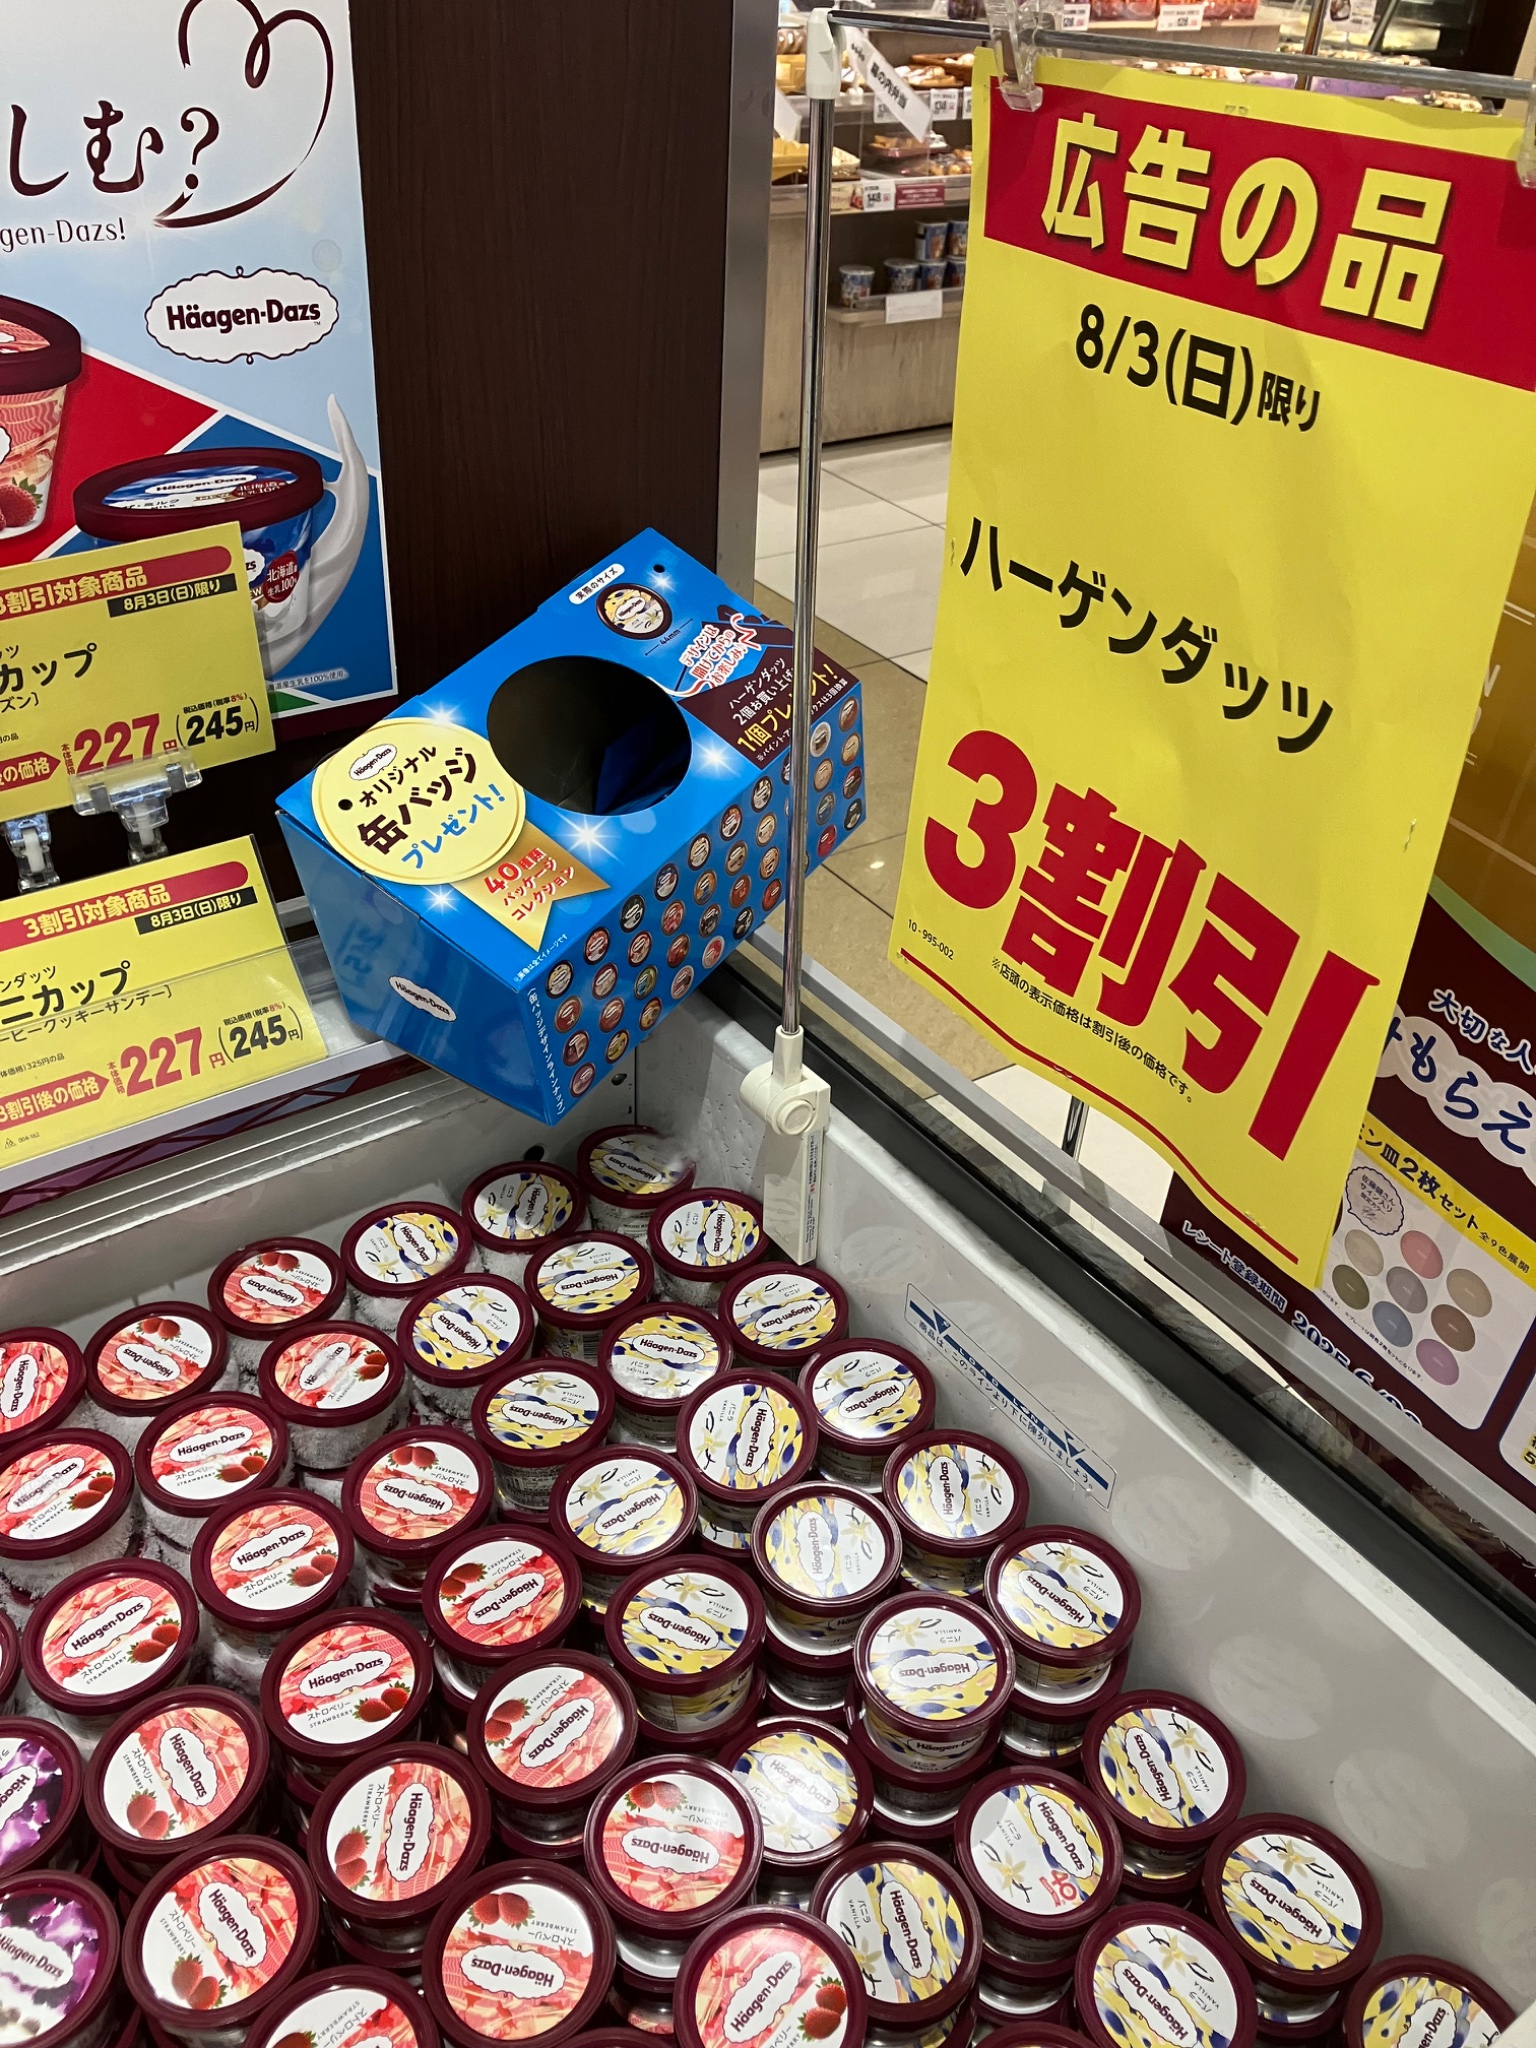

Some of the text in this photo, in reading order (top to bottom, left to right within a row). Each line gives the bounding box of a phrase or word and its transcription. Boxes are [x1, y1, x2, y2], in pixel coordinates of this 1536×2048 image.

[10, 100, 220, 196] しむ?
[1041, 112, 1452, 331] 広告の品
[166, 299, 320, 334] Häagen-Dazs
[1075, 304, 1320, 432] 8/3(日)限り
[157, 476, 247, 492] Häagen-Dazs
[123, 579, 221, 611] 8月3日(日)限り
[575, 567, 618, 600] 実際のサイズ
[660, 629, 681, 645] 44mm
[681, 626, 719, 666] デザインは
[958, 514, 1334, 754] ハーゲンダッツ
[728, 657, 787, 709] ハーゲンダッツ
[0, 761, 51, 785] の価格
[353, 748, 393, 778] Häagen-Dazs
[358, 746, 437, 809] オリジナル
[357, 747, 477, 856] 缶バッジ
[401, 783, 506, 870] プレゼント!
[484, 847, 547, 896] 40種類
[503, 856, 558, 907] パッケージ
[511, 866, 575, 922] コレクション
[23, 883, 171, 939] 3割引対象商品
[150, 893, 242, 928] 8月3日(日)限り
[512, 933, 569, 983] ※画像は全てイメージです
[923, 729, 1380, 1162] 3割引
[395, 980, 451, 1016] Häagen-Dazs
[991, 956, 1194, 1104] ※店頭の表示価格は割引後の価格です。
[1430, 988, 1532, 1074] 大切な人
[400, 1225, 431, 1263] Häagen-Dazs
[712, 1213, 727, 1254] Häagen-Dazs
[246, 1278, 299, 1305] Häagen-Dazs
[561, 1272, 619, 1293] Häagen-Dazs
[1182, 1220, 1288, 1314] レシート登録期間
[437, 1314, 481, 1350] Häagen-Dazs
[761, 1303, 816, 1329] Häagen-Dazs
[123, 1347, 174, 1379] Häagen-Dazs
[639, 1337, 698, 1360] Häagen-Dazs
[10, 1358, 30, 1413] Häagen-Dazs
[845, 1383, 900, 1413] Häagen-Dazs
[509, 1404, 568, 1427] Häagen-Dazs
[744, 1407, 768, 1468] Häagen-Dazs
[177, 1430, 246, 1457] Häagen-Dazs
[383, 1482, 446, 1512] Häagen-Dazs
[601, 1491, 661, 1530] Häagen-Dazs
[939, 1461, 954, 1516] Häagen-Dazs
[236, 1528, 307, 1567] Häagen-Dazs
[808, 1517, 824, 1575] Häagen-Dazs
[474, 1578, 540, 1619] Häagen-Dazs
[1026, 1574, 1084, 1623] Häagen-Dazs
[71, 1601, 145, 1652] Häagen-Dazs
[648, 1612, 711, 1645] Häagen-Dazs
[307, 1656, 385, 1690] Häagen-Dazs
[899, 1662, 970, 1677] Häagen-Dazs
[527, 1704, 590, 1762] Häagen-Dazs
[169, 1733, 208, 1799] Häagen-Dazs
[769, 1758, 832, 1807] Häagen-Dazs
[1134, 1734, 1172, 1802] Häagen-Dazs
[399, 1792, 424, 1873] Häagen-Dazs
[631, 1836, 711, 1865] Häagen-Dazs
[1037, 1801, 1086, 1871] Häagen-Dazs
[1051, 1869, 1077, 1901] 40
[1249, 1877, 1323, 1938] Häagen-Dazs
[208, 1888, 258, 1959] Häagen-Dazs
[889, 1889, 923, 1970] Häagen-Dazs
[470, 1956, 555, 1988] Häagen-Dazs
[730, 1959, 795, 2033] Häagen-Dazs
[1122, 1967, 1188, 2042] Häagen-Dazs
